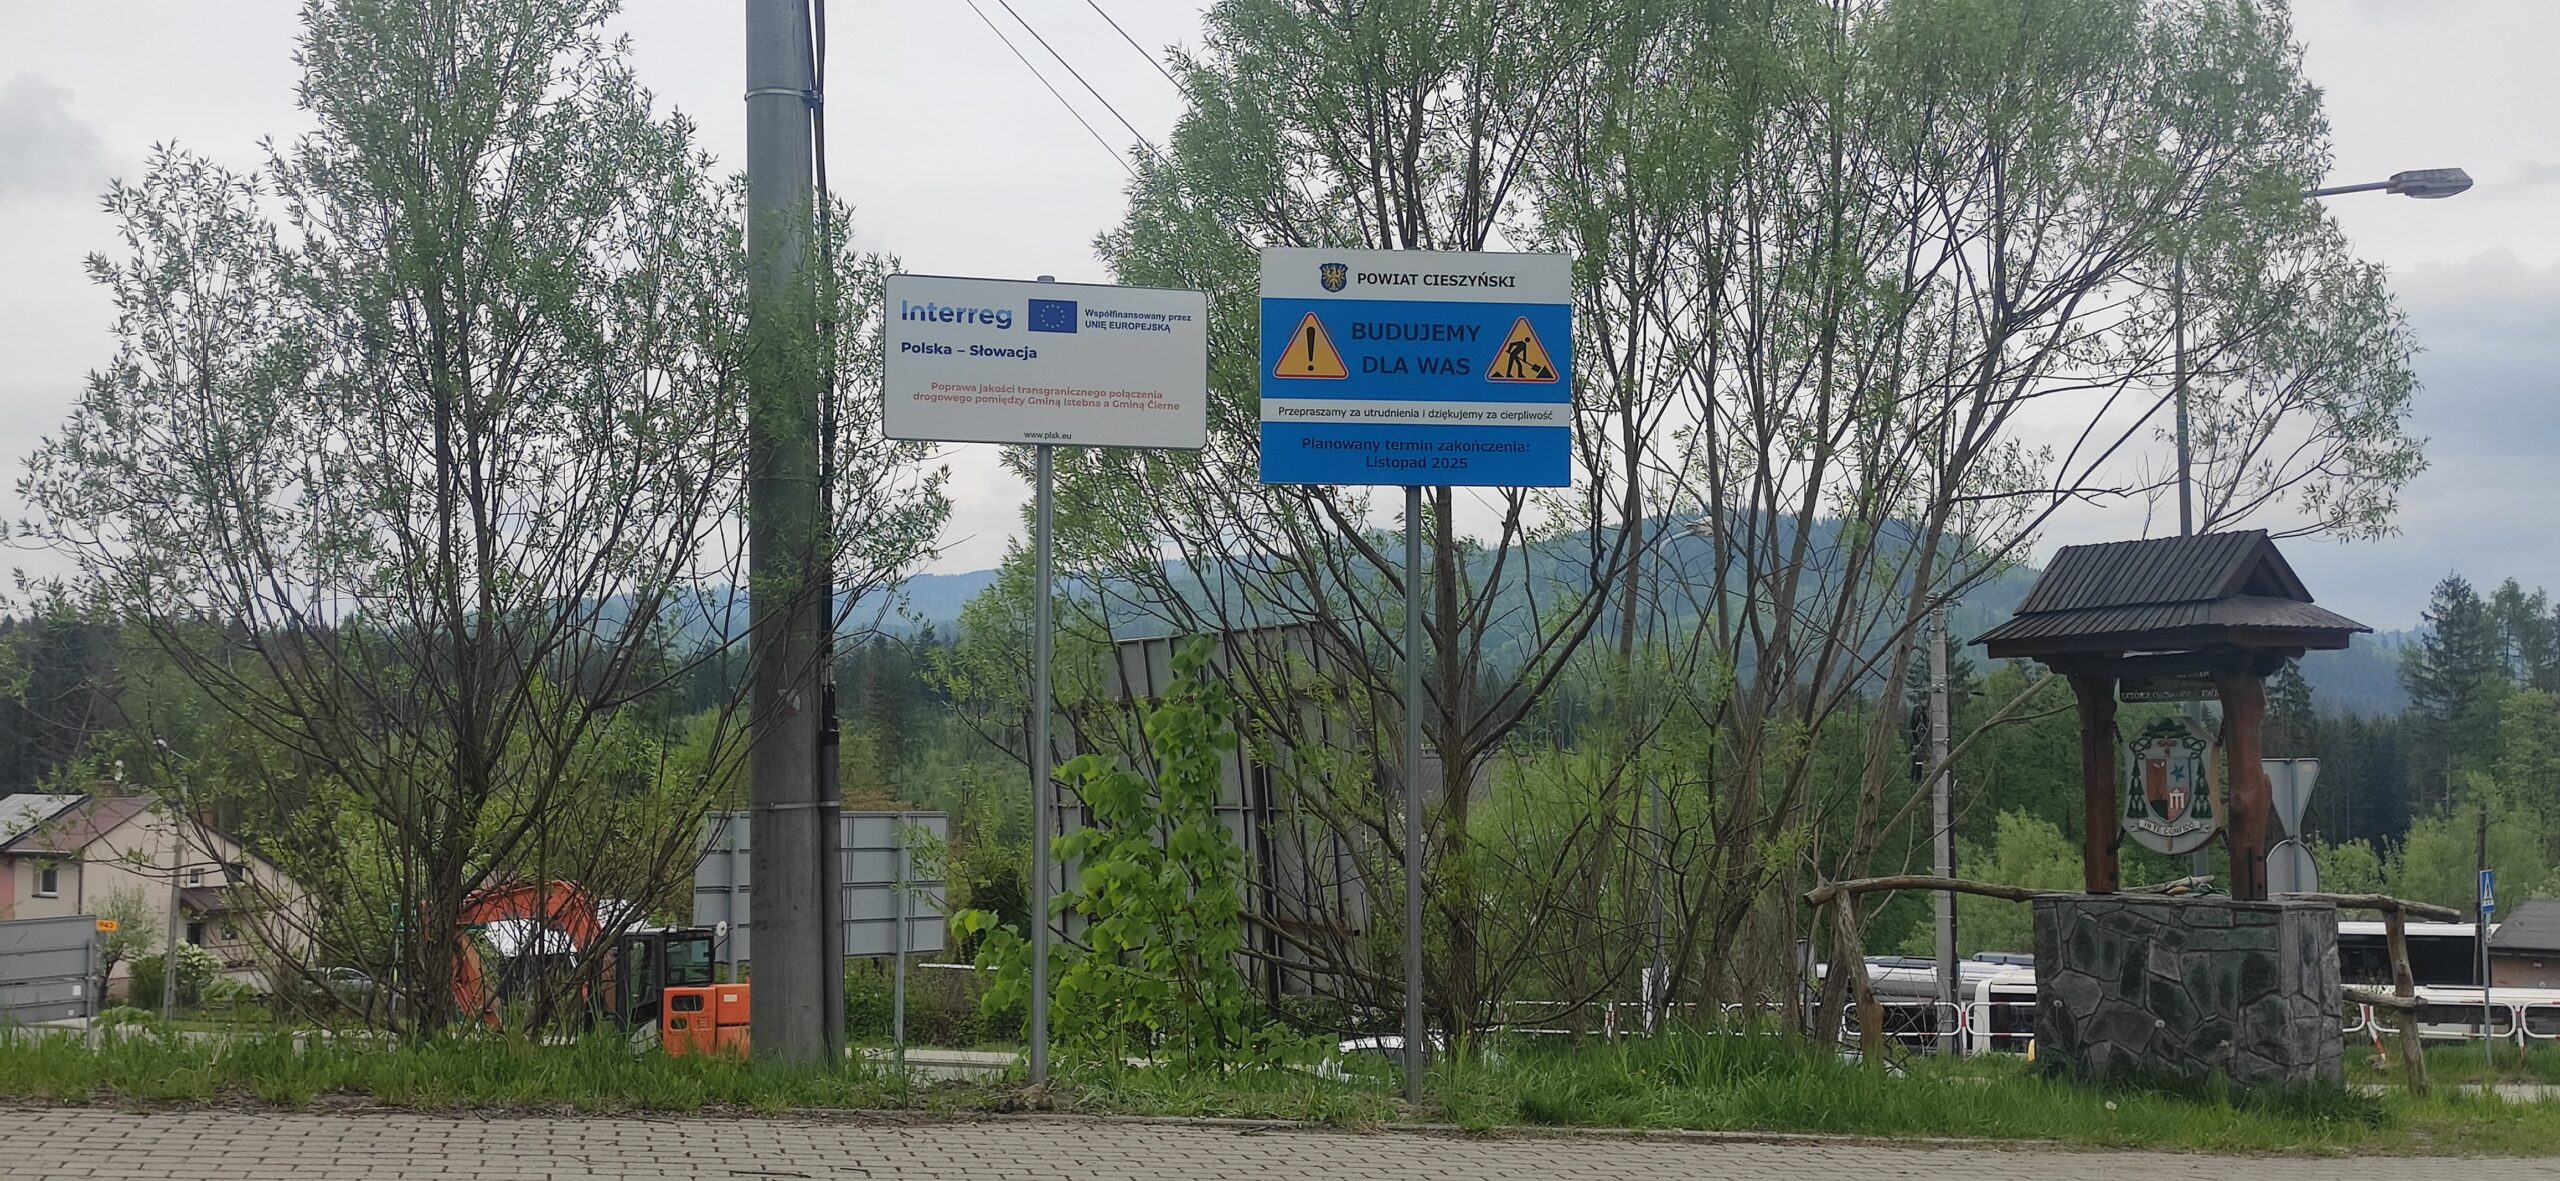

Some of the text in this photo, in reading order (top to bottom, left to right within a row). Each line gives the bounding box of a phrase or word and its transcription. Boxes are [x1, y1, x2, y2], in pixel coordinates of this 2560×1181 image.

[1357, 271, 1516, 288] POWIAT CIESZYŃSKI
[901, 300, 1012, 329] Interreg
[1085, 308, 1191, 323] Współfinansowany przez
[1085, 320, 1171, 333] UNIĘ EUROPEJSKĄ
[1352, 322, 1481, 342] BUDUJEMY
[901, 342, 952, 356] Polska
[970, 344, 1037, 361] Słowacja
[1362, 356, 1470, 375] DLA WAS
[931, 381, 1163, 401] Poprawa jakości transgranicznego połączenia
[913, 392, 973, 405] drogowego
[975, 395, 1025, 407] pomiędzy
[1028, 396, 1061, 408] Gminą
[1064, 398, 1101, 408] Istebna
[1112, 399, 1145, 411] Gminą
[1148, 398, 1180, 410] Čierne
[1278, 406, 1553, 422] Przepraszamy za utrudnienia i dziękujemy za cierpliwość
[1024, 431, 1072, 440] www.plsk.eu
[1302, 437, 1530, 453] Planowany termin zakończenia:
[1365, 456, 1468, 470] Listopad 2025
[2164, 823, 2193, 834] CONFIDO
